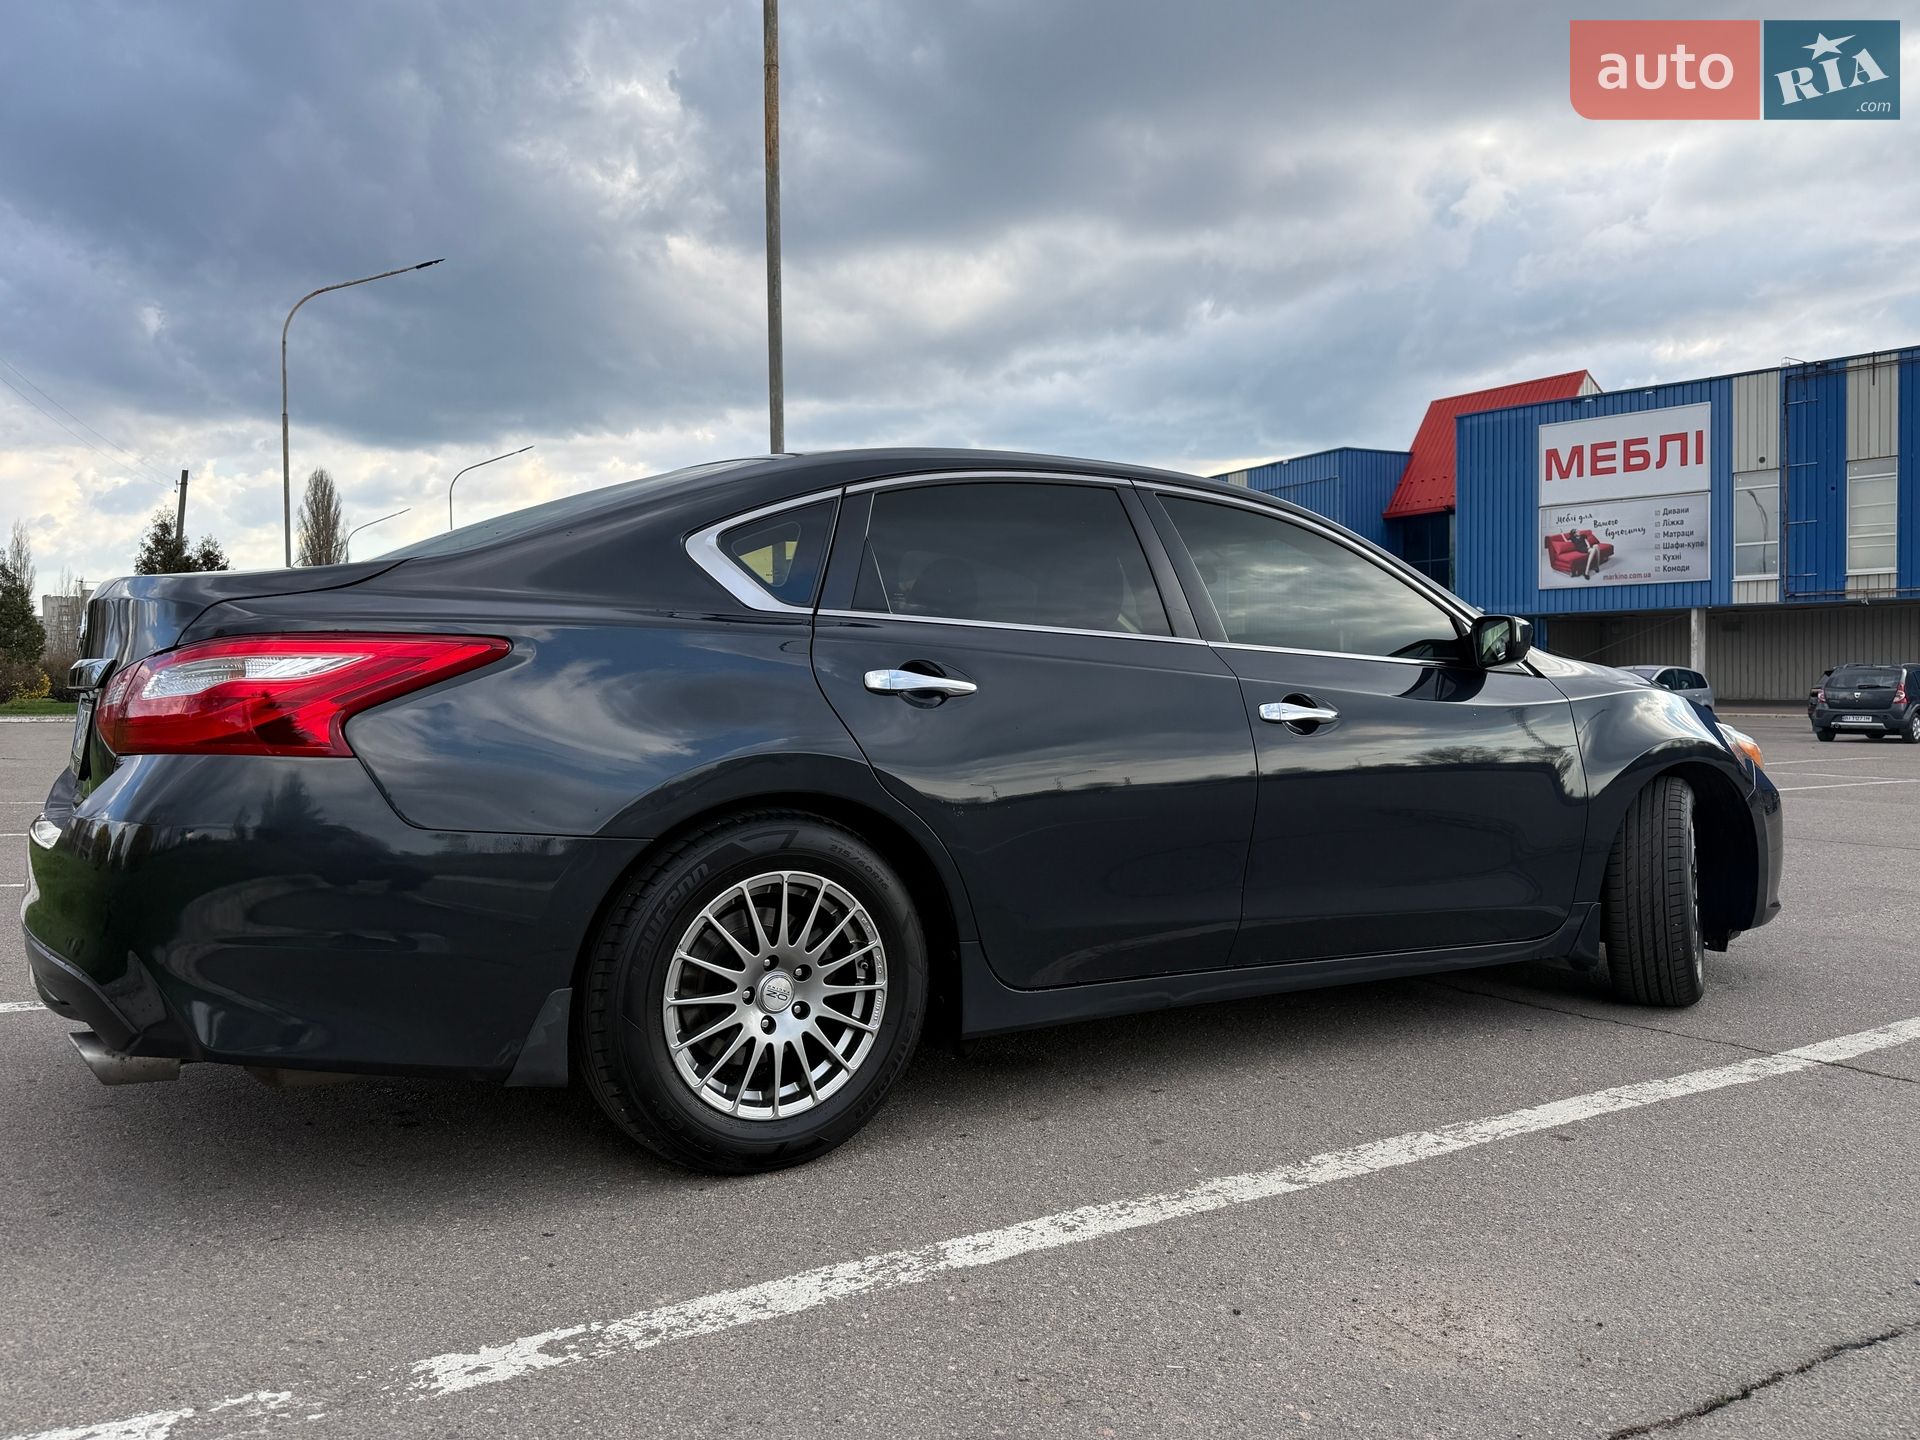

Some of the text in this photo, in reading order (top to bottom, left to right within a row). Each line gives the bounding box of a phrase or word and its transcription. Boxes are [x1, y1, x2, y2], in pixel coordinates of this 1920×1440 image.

[1545, 430, 1704, 481] МЕБЛІ
[1662, 507, 1690, 517] Дивани
[1662, 518, 1685, 527] Ліжка
[1662, 530, 1695, 539] Матраци
[1662, 540, 1705, 551] Шафи-купе
[1662, 552, 1682, 562] Кухні
[1662, 564, 1690, 573] Комоди
[1602, 571, 1652, 581] markino.com.ua
